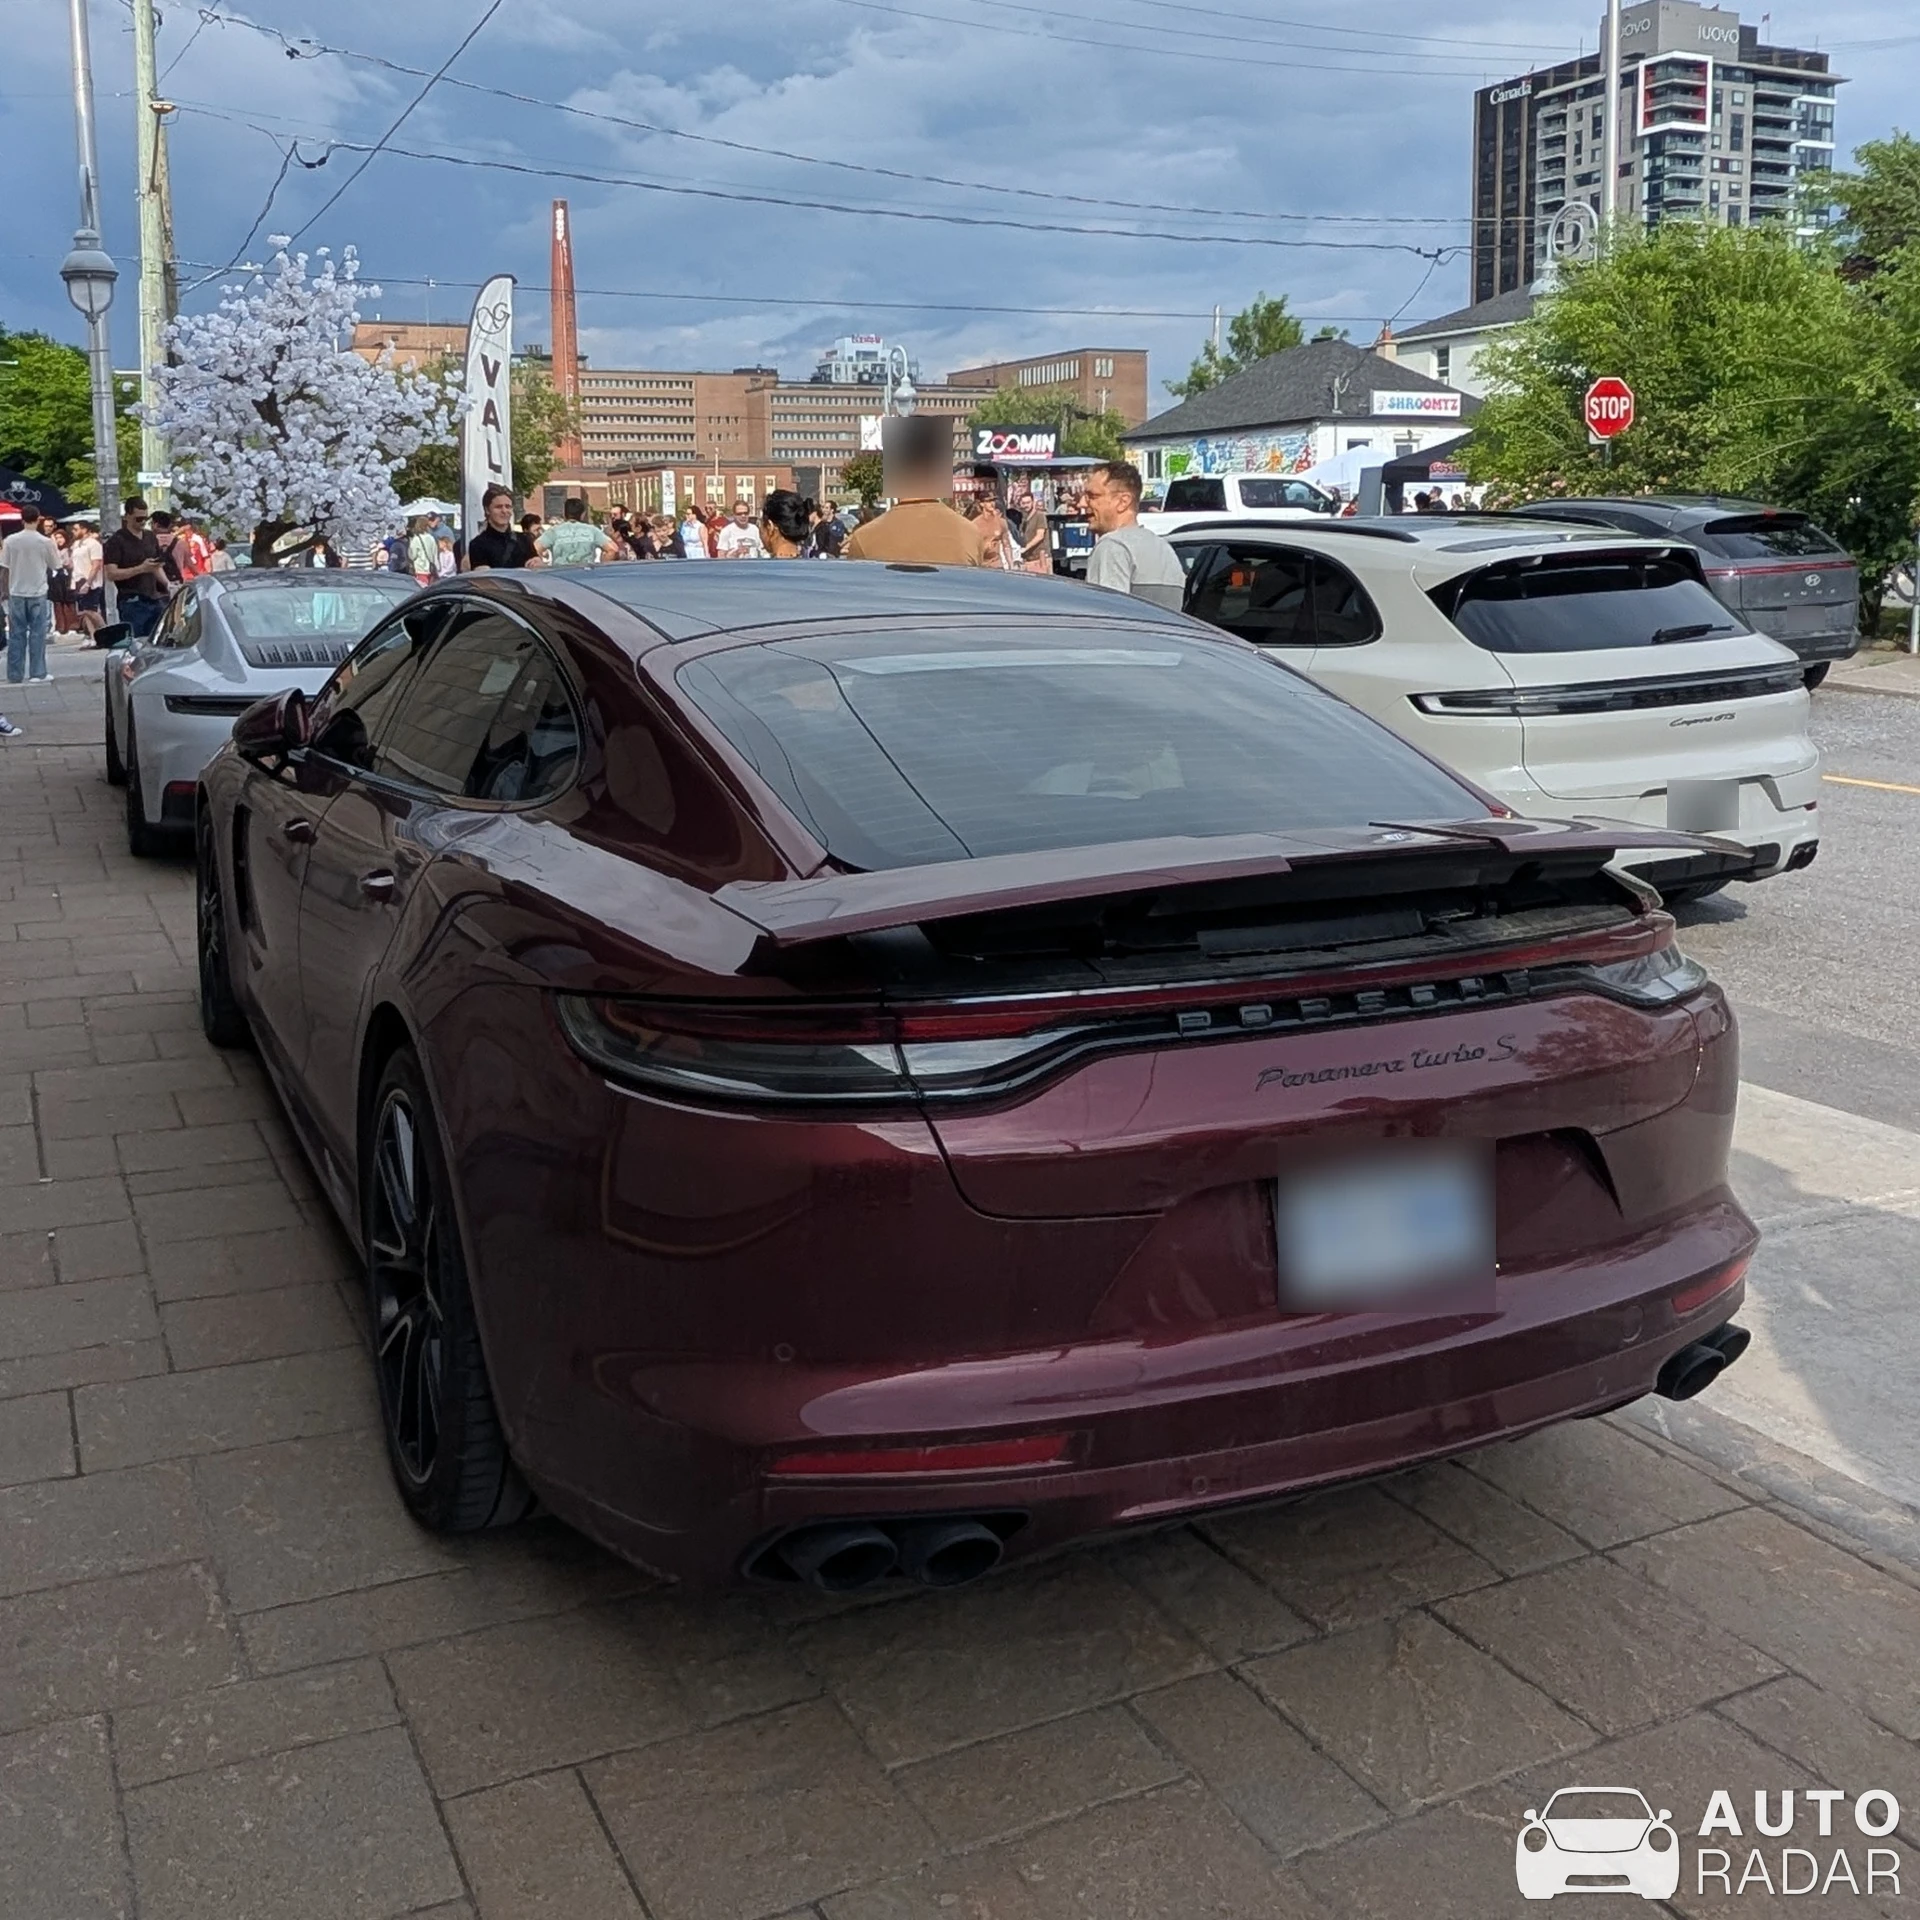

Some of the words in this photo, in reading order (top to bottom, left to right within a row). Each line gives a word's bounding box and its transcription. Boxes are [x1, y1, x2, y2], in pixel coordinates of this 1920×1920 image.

[1490, 80, 1532, 105] Canada
[1590, 396, 1630, 420] STOP
[1255, 1060, 1405, 1092] Panamera
[1487, 1033, 1518, 1062] S
